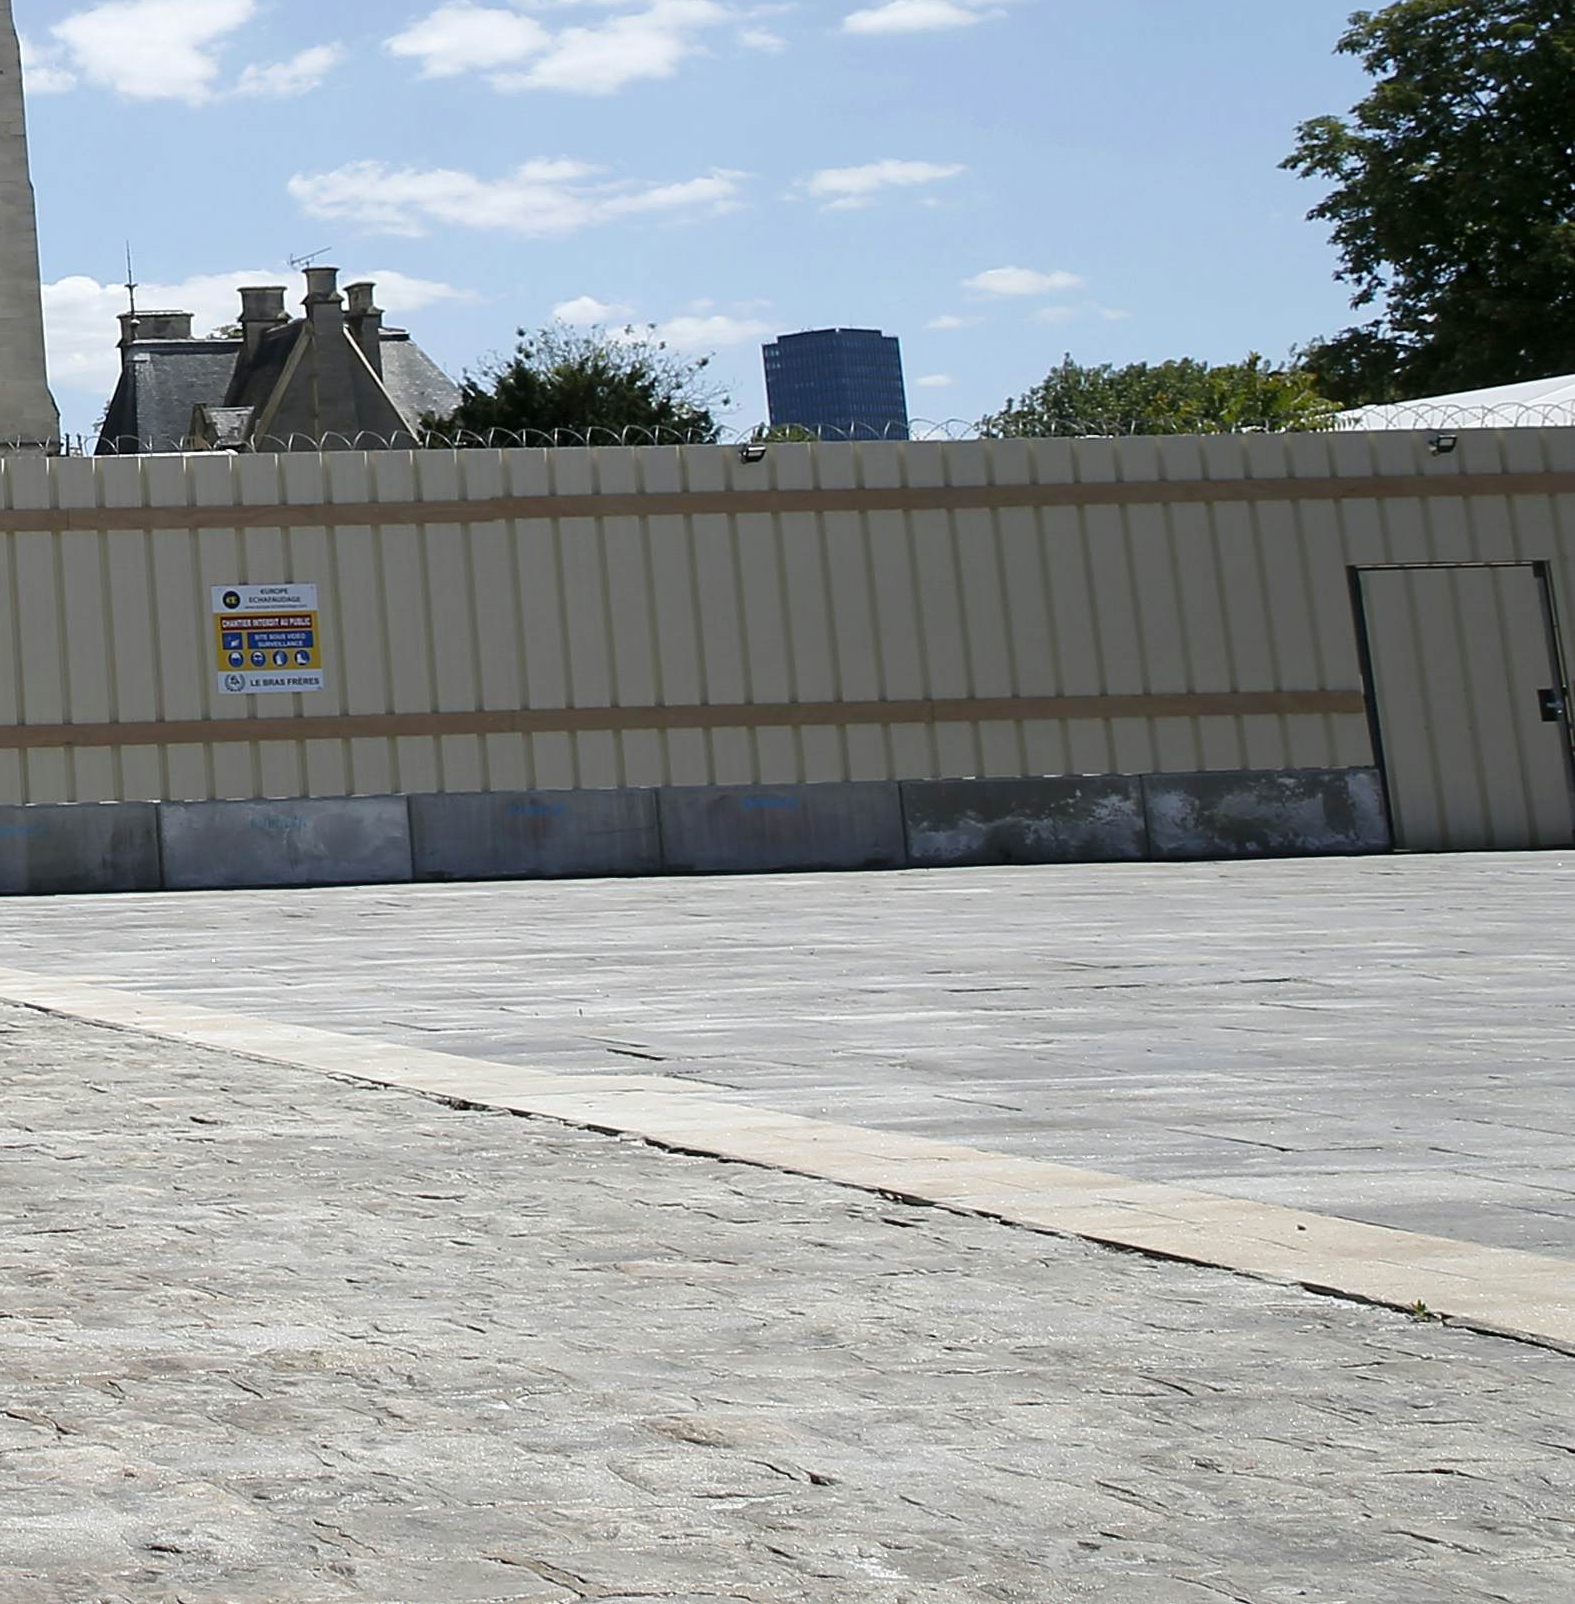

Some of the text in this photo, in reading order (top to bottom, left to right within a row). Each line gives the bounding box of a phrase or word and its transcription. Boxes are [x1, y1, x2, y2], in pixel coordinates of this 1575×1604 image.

[222, 617, 311, 628] CHANTIER INTERDIT AU PUBLIC
